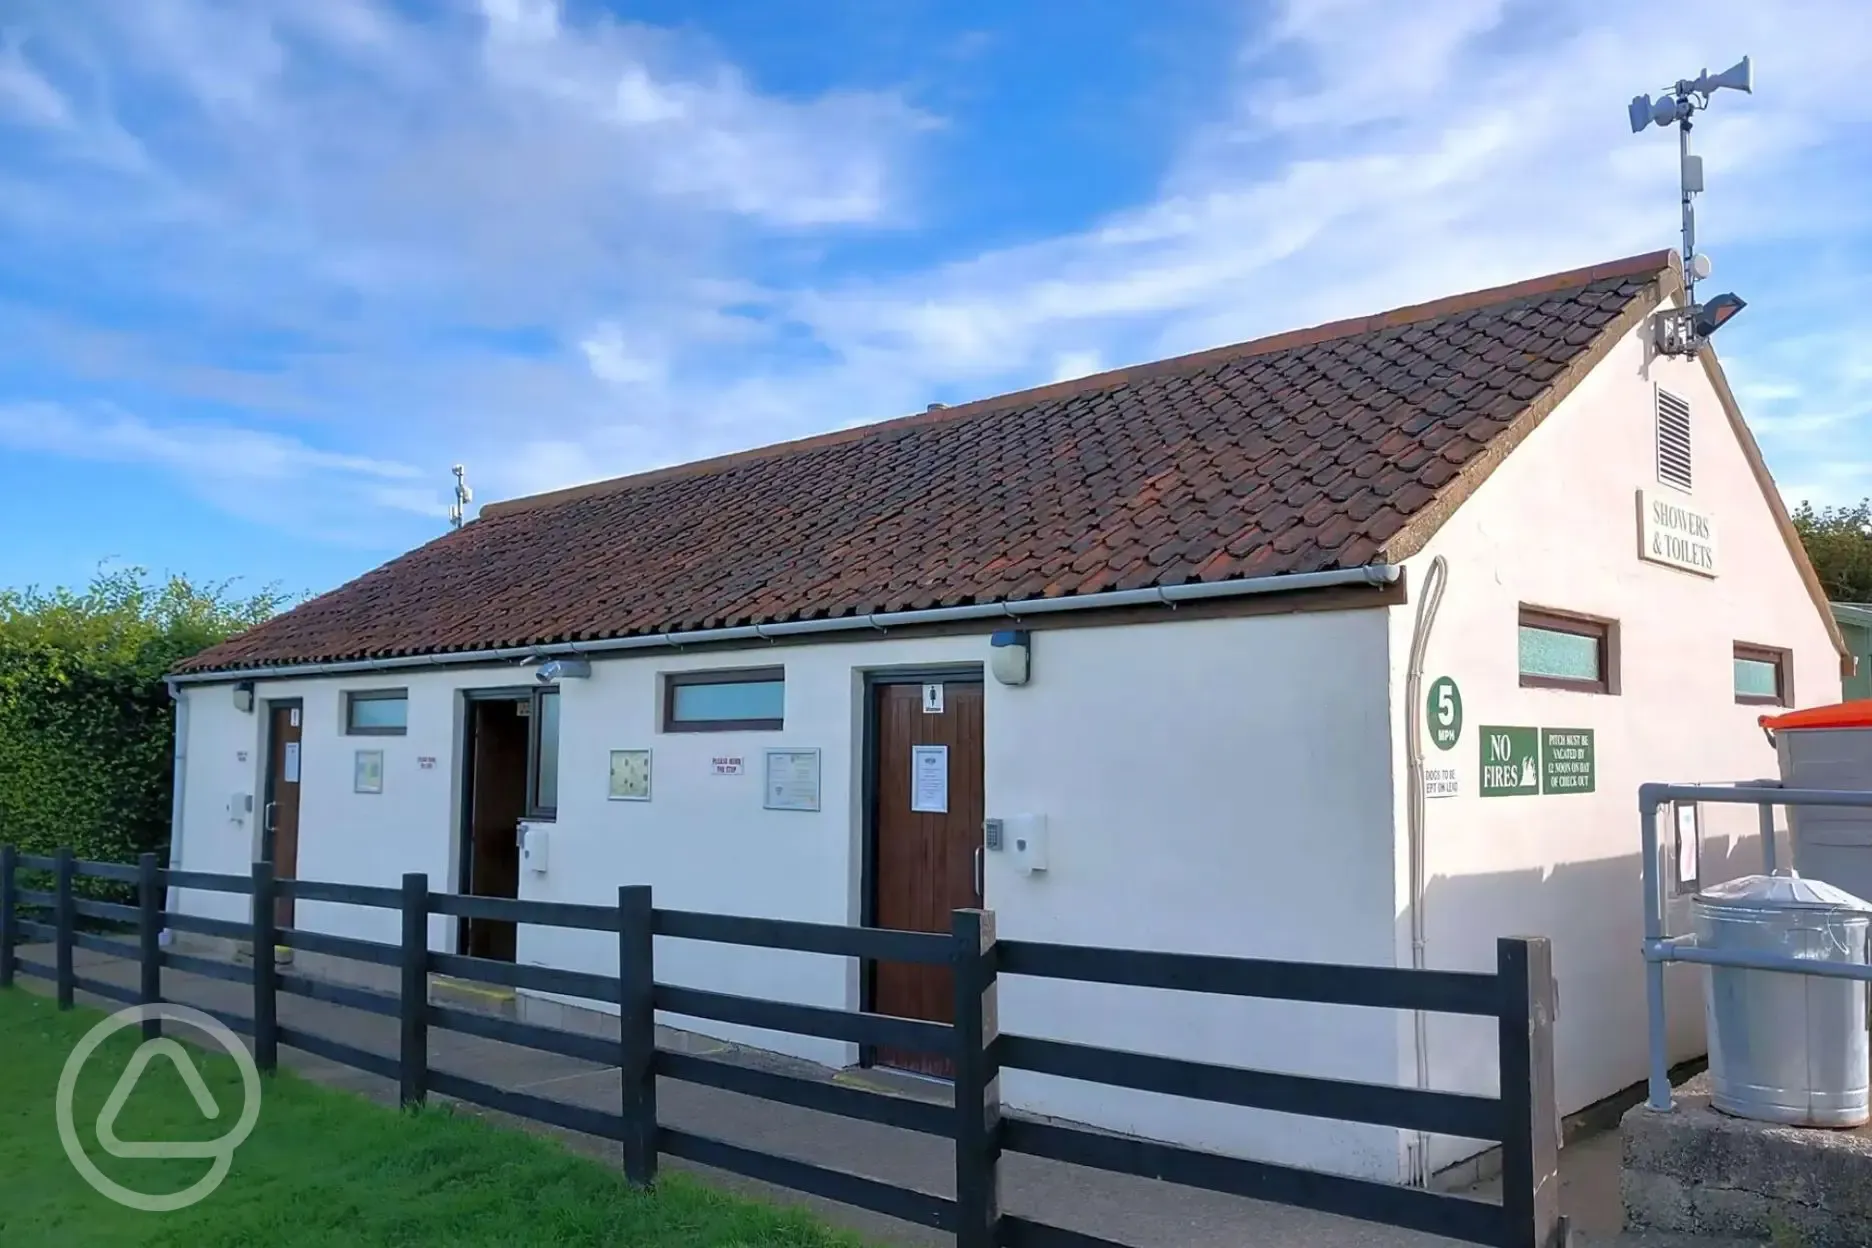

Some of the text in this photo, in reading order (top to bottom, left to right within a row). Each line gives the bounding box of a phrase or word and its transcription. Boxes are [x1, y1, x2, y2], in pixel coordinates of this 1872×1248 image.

[1653, 500, 1710, 540] SHOWERS
[1653, 531, 1713, 569] & TOILETS
[1438, 685, 1454, 726] 5
[1438, 730, 1455, 742] MPH
[1548, 735, 1589, 746] PITCH MUST BE
[1490, 735, 1511, 761] NO
[1553, 748, 1585, 759] VACATED BY
[1555, 763, 1571, 774] NOON
[1571, 762, 1579, 774] ON
[1425, 769, 1456, 780] DOGS TO BE
[1483, 765, 1519, 788] FIRES
[1426, 782, 1437, 794] EPT
[1550, 776, 1589, 788] OF CHECK OUT
